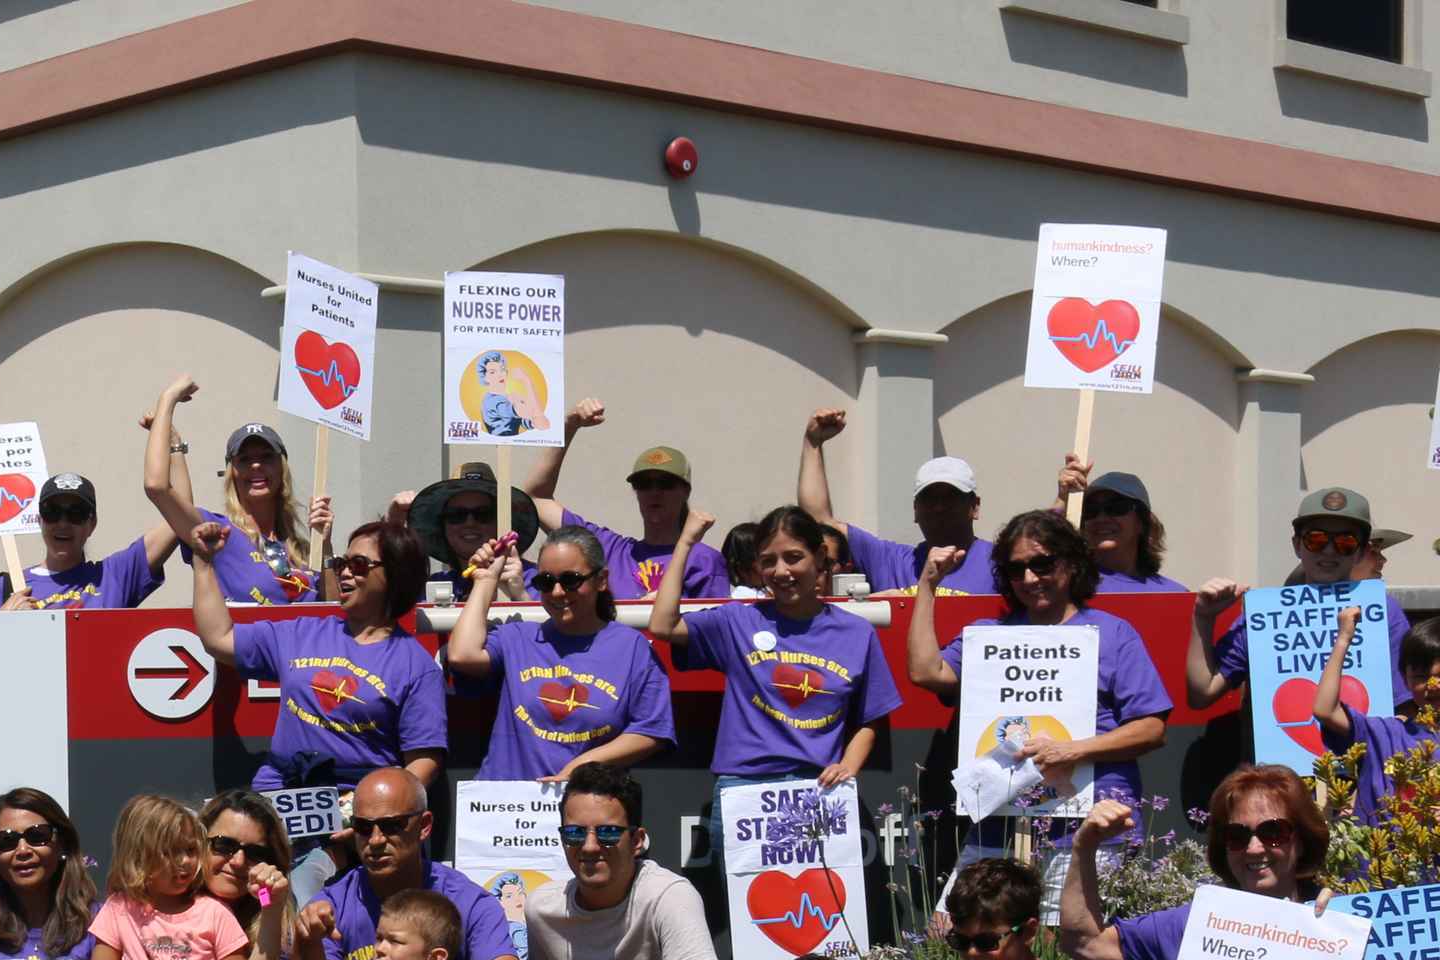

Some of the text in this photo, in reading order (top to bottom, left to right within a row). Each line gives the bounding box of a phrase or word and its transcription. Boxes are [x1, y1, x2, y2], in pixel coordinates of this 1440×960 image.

[1052, 240, 1153, 255] humankindness?
[1051, 256, 1098, 268] Where?
[297, 270, 373, 306] Nurses United
[459, 285, 557, 299] FLEXING OUR
[327, 296, 342, 309] for
[311, 304, 355, 328] Patients
[452, 301, 561, 323] NURSE POWER
[453, 325, 561, 337] FOR PATIENT SAFETY
[6, 447, 32, 461] por
[1280, 584, 1351, 606] SAFE
[1250, 604, 1385, 632] STAFFG
[779, 651, 826, 668] Nurses
[984, 644, 1081, 660] Patients
[1005, 666, 1059, 681] Over
[1000, 687, 1063, 703] Profit
[558, 731, 590, 743] Patient
[469, 801, 560, 812] Nurses Uni
[281, 813, 334, 835] ED!
[516, 818, 536, 830] for
[493, 836, 559, 848] Patients
[1351, 887, 1440, 919] SAFE
[1206, 912, 1349, 956] humankindness?
